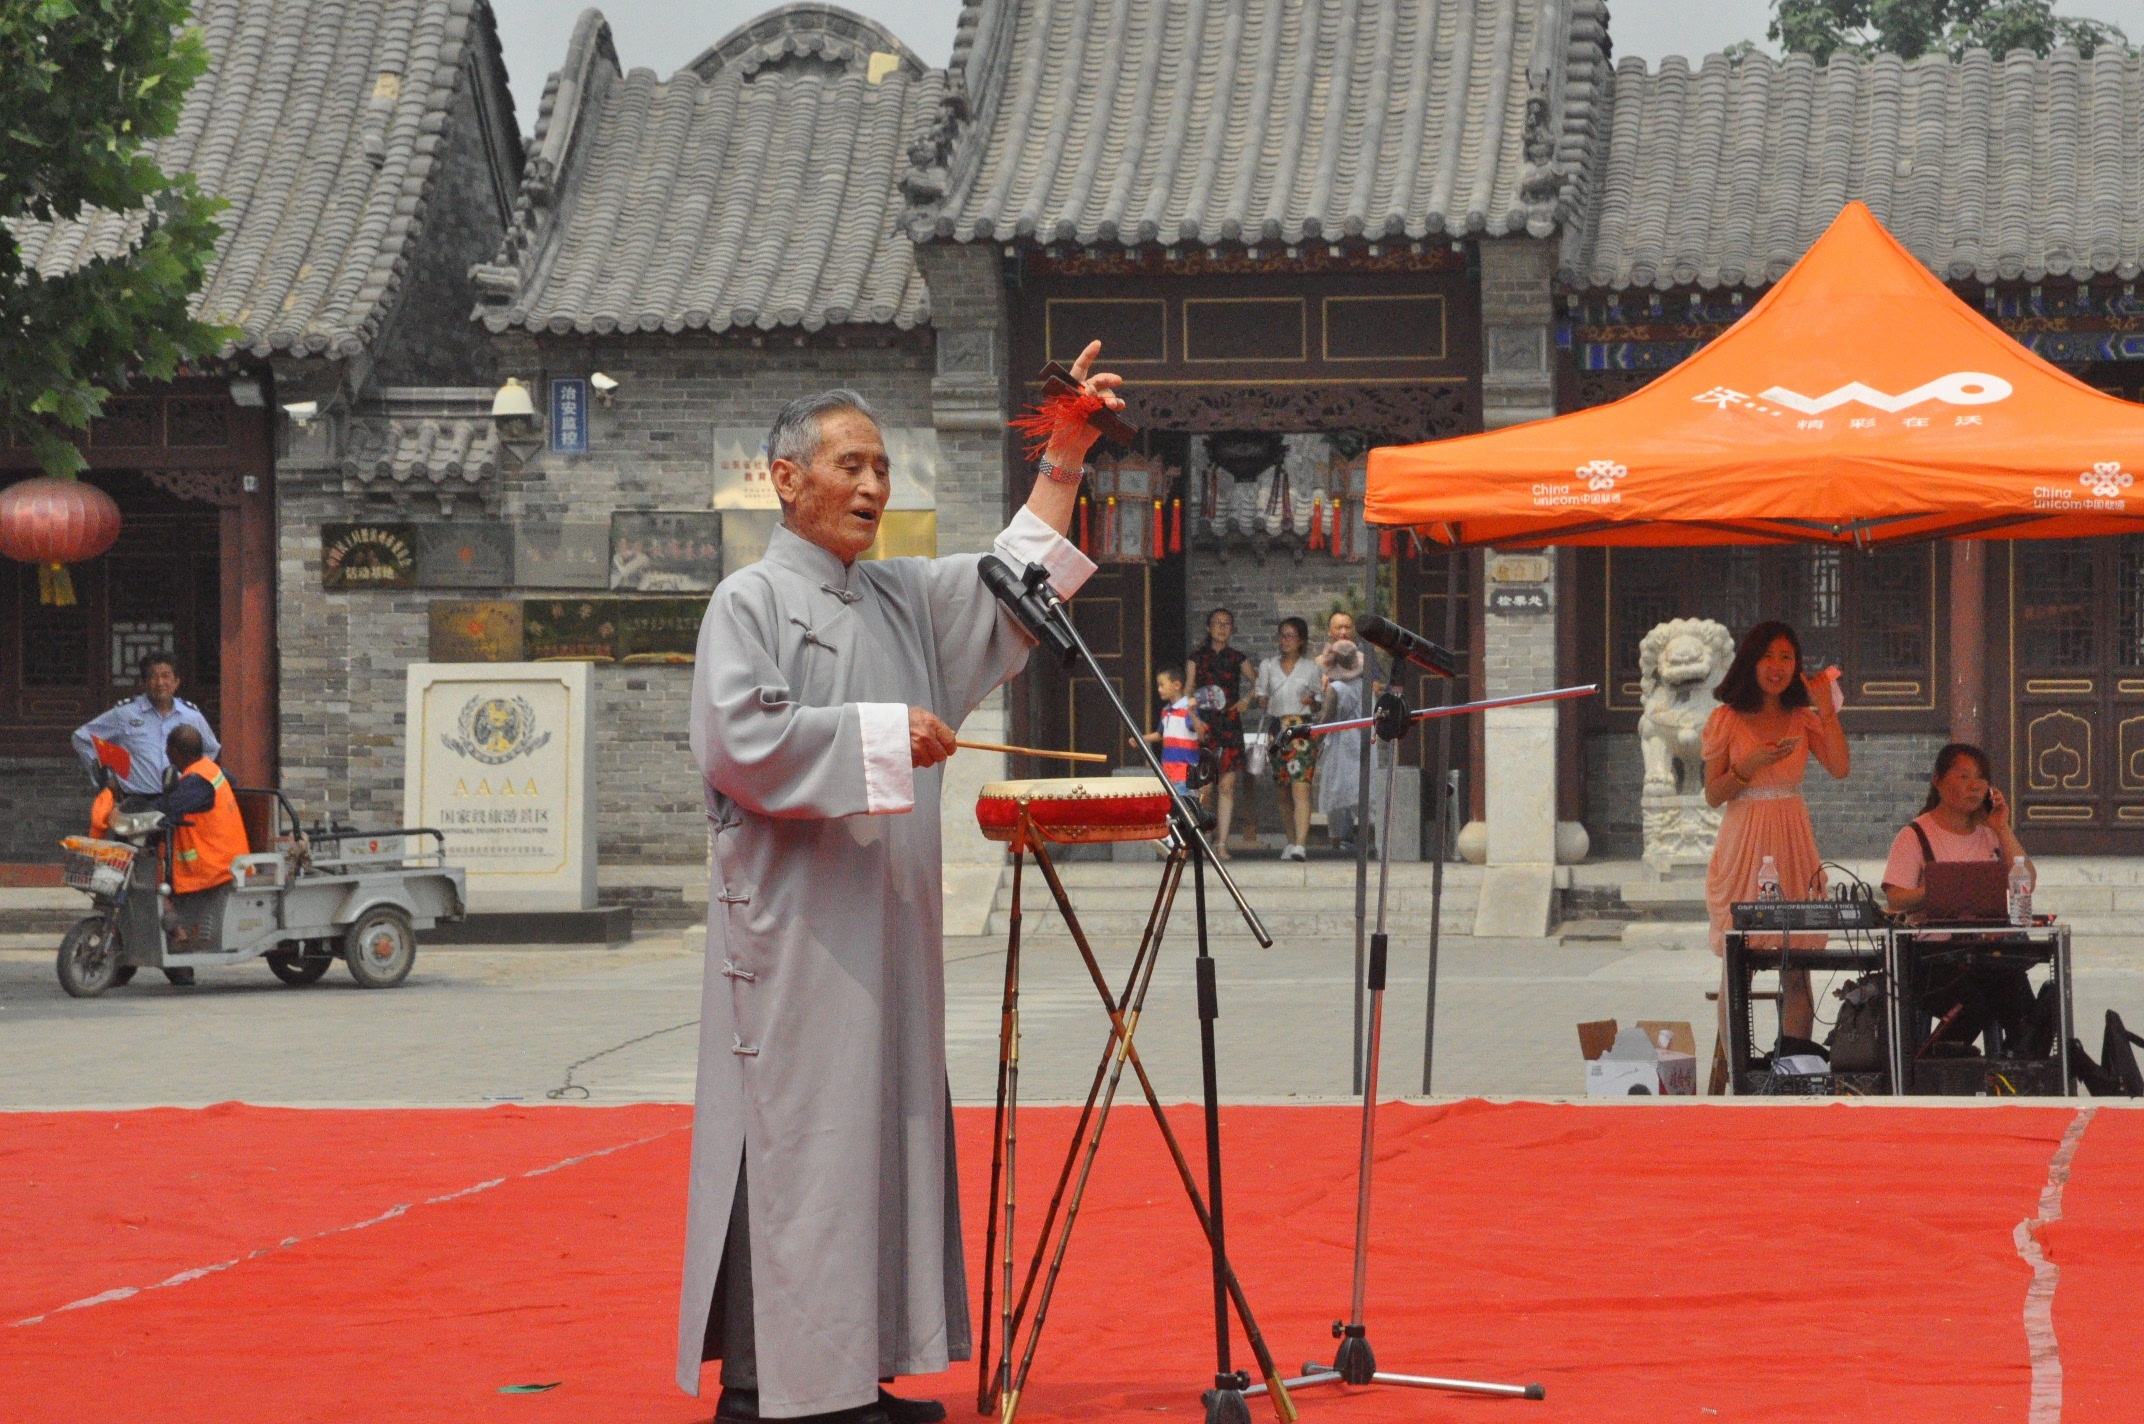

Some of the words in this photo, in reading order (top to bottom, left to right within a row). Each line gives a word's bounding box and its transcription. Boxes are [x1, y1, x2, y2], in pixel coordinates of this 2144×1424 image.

[561, 386, 578, 446] 治安监控
[1531, 483, 1570, 496] China
[2032, 486, 2072, 499] China
[1496, 595, 1544, 607] 检票处
[440, 807, 549, 824] 国家级旅游景区
